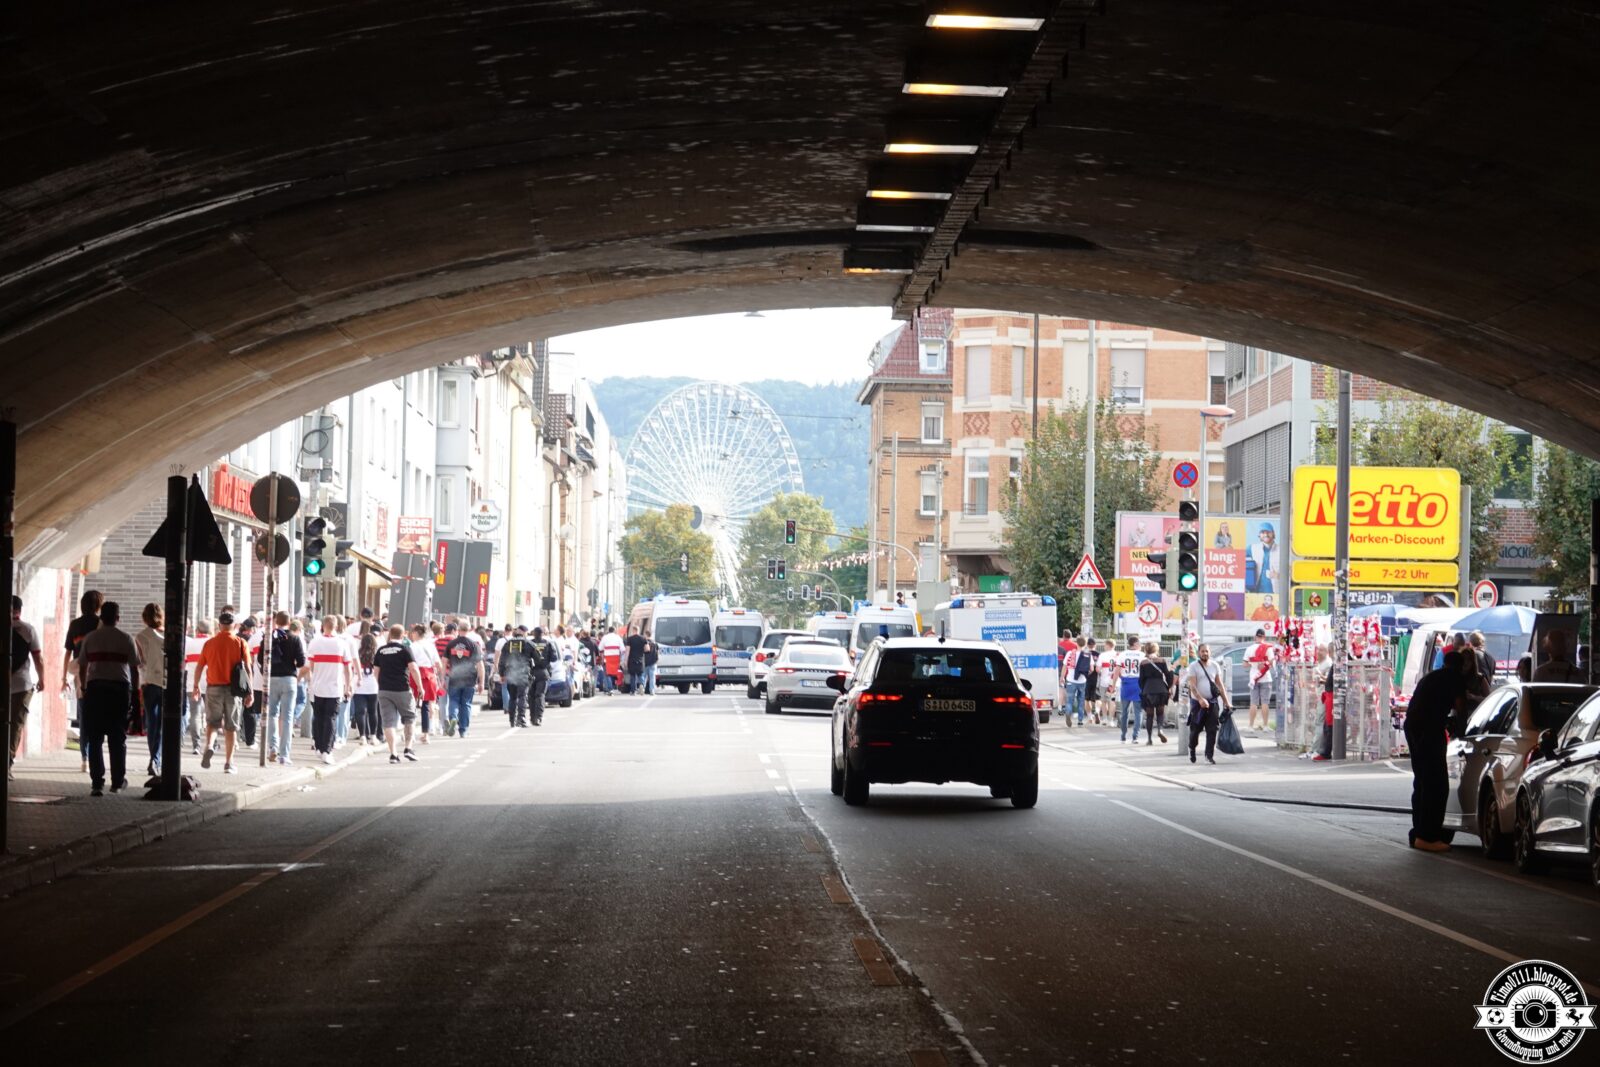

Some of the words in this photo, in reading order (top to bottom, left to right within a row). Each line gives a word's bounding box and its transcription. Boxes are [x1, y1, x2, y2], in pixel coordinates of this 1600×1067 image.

[1304, 480, 1448, 528] Netto
[1209, 551, 1236, 564] lang:
[1382, 569, 1407, 579] 7-22
[1410, 568, 1430, 579] Uhr
[659, 647, 684, 655] OLIZEI
[1124, 658, 1139, 674] 93
